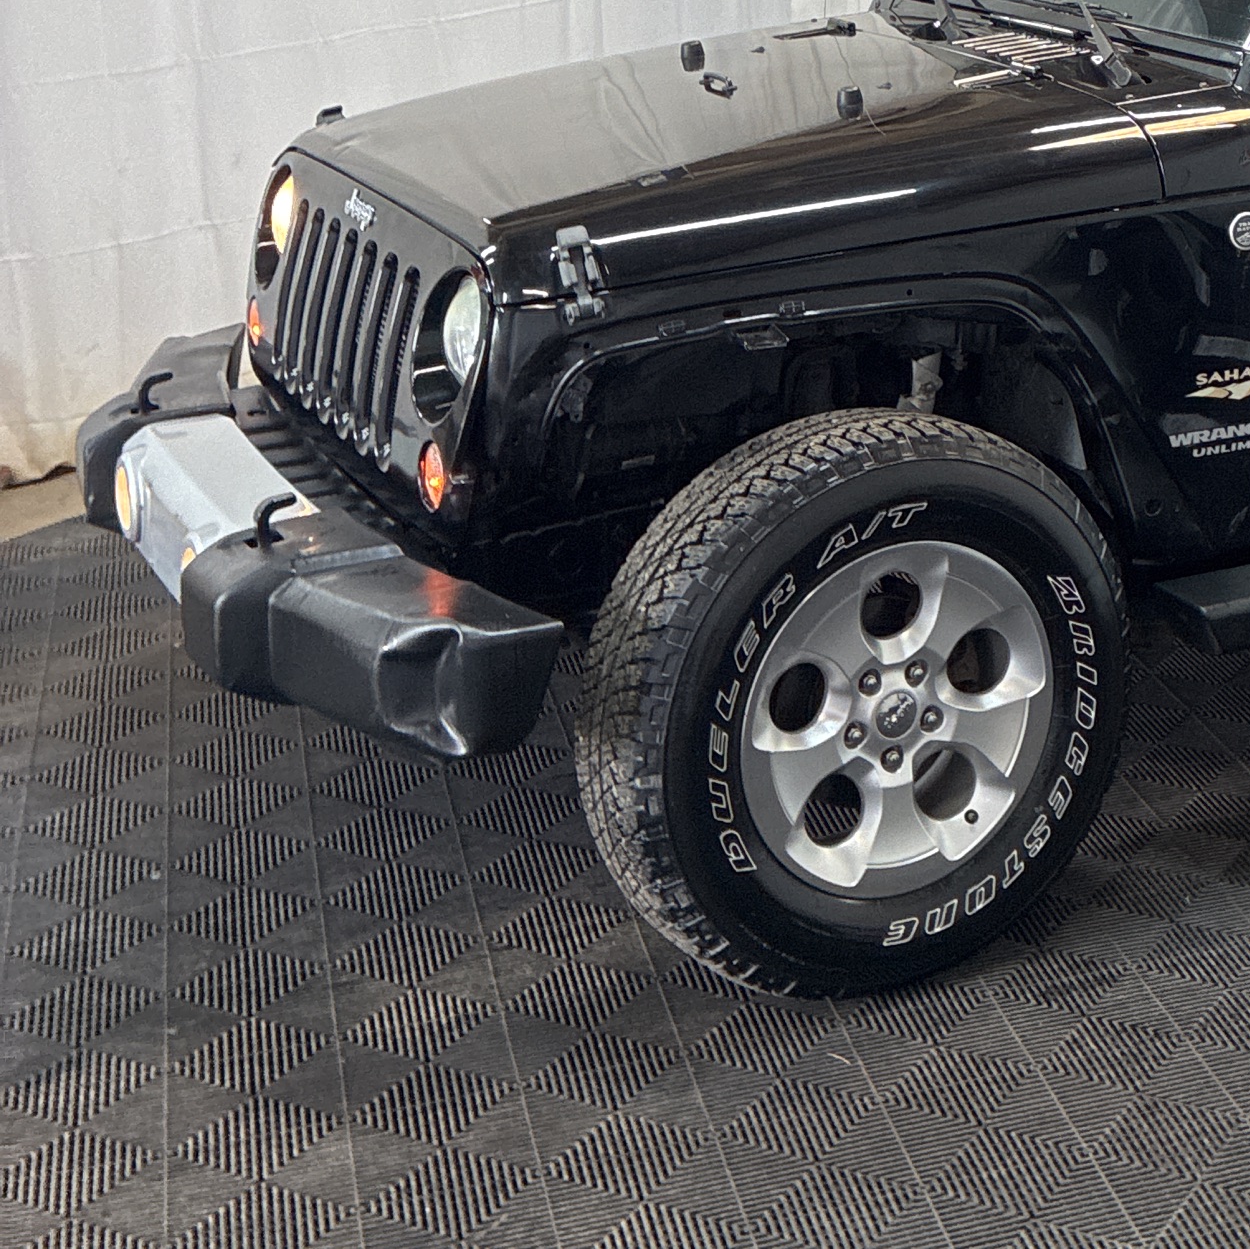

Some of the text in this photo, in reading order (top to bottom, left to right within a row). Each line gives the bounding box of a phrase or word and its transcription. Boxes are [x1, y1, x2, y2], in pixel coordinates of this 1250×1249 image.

[703, 501, 928, 875] DUELER A/T
[881, 574, 1099, 949] BRIDGESTONE
